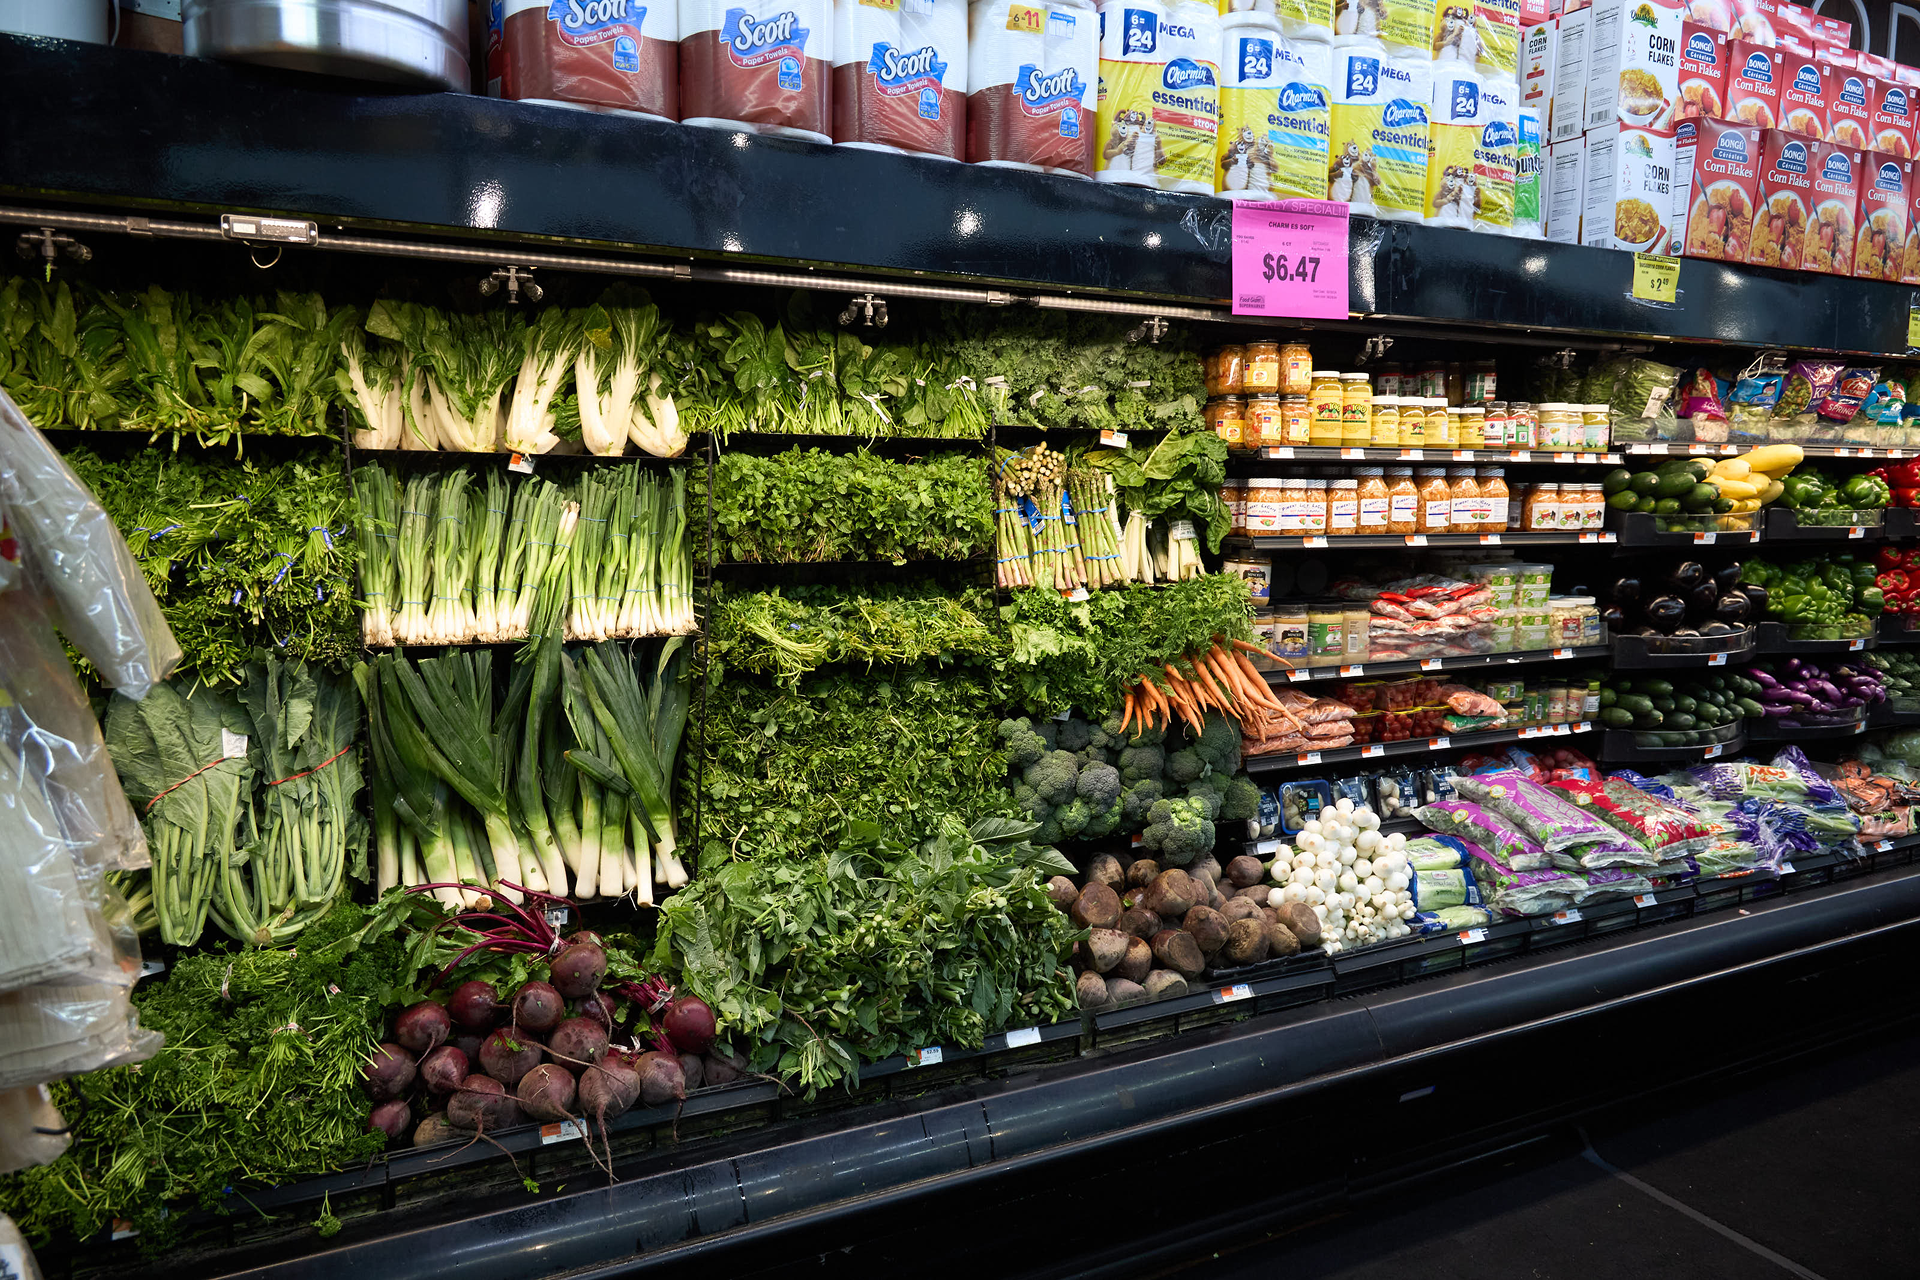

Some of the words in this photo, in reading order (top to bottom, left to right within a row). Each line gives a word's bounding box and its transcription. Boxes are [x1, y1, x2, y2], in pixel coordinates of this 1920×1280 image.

[564, 0, 628, 28] Scott
[1014, 14, 1020, 22] 6
[1024, 10, 1040, 28] 11
[574, 34, 598, 44] Paper
[598, 26, 624, 40] Towels
[734, 11, 796, 50] Scott
[1128, 28, 1153, 48] 24
[1160, 22, 1196, 40] MEGA
[1528, 36, 1548, 48] CORN
[1528, 44, 1547, 55] FLAKES
[1649, 34, 1676, 54] CORN
[1690, 39, 1712, 52] BONGÚ
[742, 56, 764, 66] Paper
[766, 48, 788, 61] Towels
[880, 46, 935, 80] Scott
[1244, 56, 1268, 75] 24
[1648, 51, 1674, 67] FLAKES
[1748, 58, 1770, 72] BONGÚ
[1166, 65, 1207, 84] Charmin
[1380, 66, 1411, 82] MEGA
[1680, 58, 1697, 72] Corn
[1698, 62, 1721, 78] Flakes
[1798, 71, 1818, 83] BONGÚ
[888, 84, 906, 95] Paper
[906, 78, 928, 90] Towels
[1026, 68, 1076, 102] Scott
[1352, 74, 1374, 92] 24
[1734, 78, 1753, 90] Corn
[1754, 81, 1776, 97] Flakes
[1846, 84, 1863, 95] BONGÚ
[1282, 88, 1320, 106] Charmin
[1456, 97, 1476, 114] 24
[1480, 92, 1506, 106] MEGA
[1786, 90, 1804, 102] Corn
[1804, 94, 1825, 108] Flakes
[1887, 94, 1905, 106] BONGÚ
[1032, 105, 1050, 115] Paper
[1050, 98, 1069, 111] Towels
[1387, 106, 1420, 122] Charmin
[1832, 101, 1849, 112] Corn
[1850, 104, 1868, 119] Flakes
[1193, 118, 1218, 134] strong
[1874, 112, 1892, 123] Corn
[1892, 115, 1912, 128] Flakes
[1720, 138, 1744, 151] BONGÚ
[1474, 149, 1516, 168] essentia
[1784, 149, 1806, 161] BONGÚ
[1644, 164, 1670, 182] CORN
[1704, 159, 1726, 174] Corn
[1728, 162, 1753, 178] Flakes
[1828, 160, 1848, 172] BONGÚ
[1880, 170, 1900, 180] BONGÚ
[1768, 170, 1788, 184] Corn
[1788, 174, 1810, 188] Flakes
[1815, 180, 1834, 193] Corn
[1834, 183, 1856, 198] Flakes
[1868, 188, 1886, 202] Corn
[1887, 192, 1906, 206] Flakes
[1268, 222, 1290, 230] CHARM
[1300, 223, 1314, 231] SOFT
[1262, 252, 1320, 284] $6.47
[1828, 403, 1854, 416] SPRING
